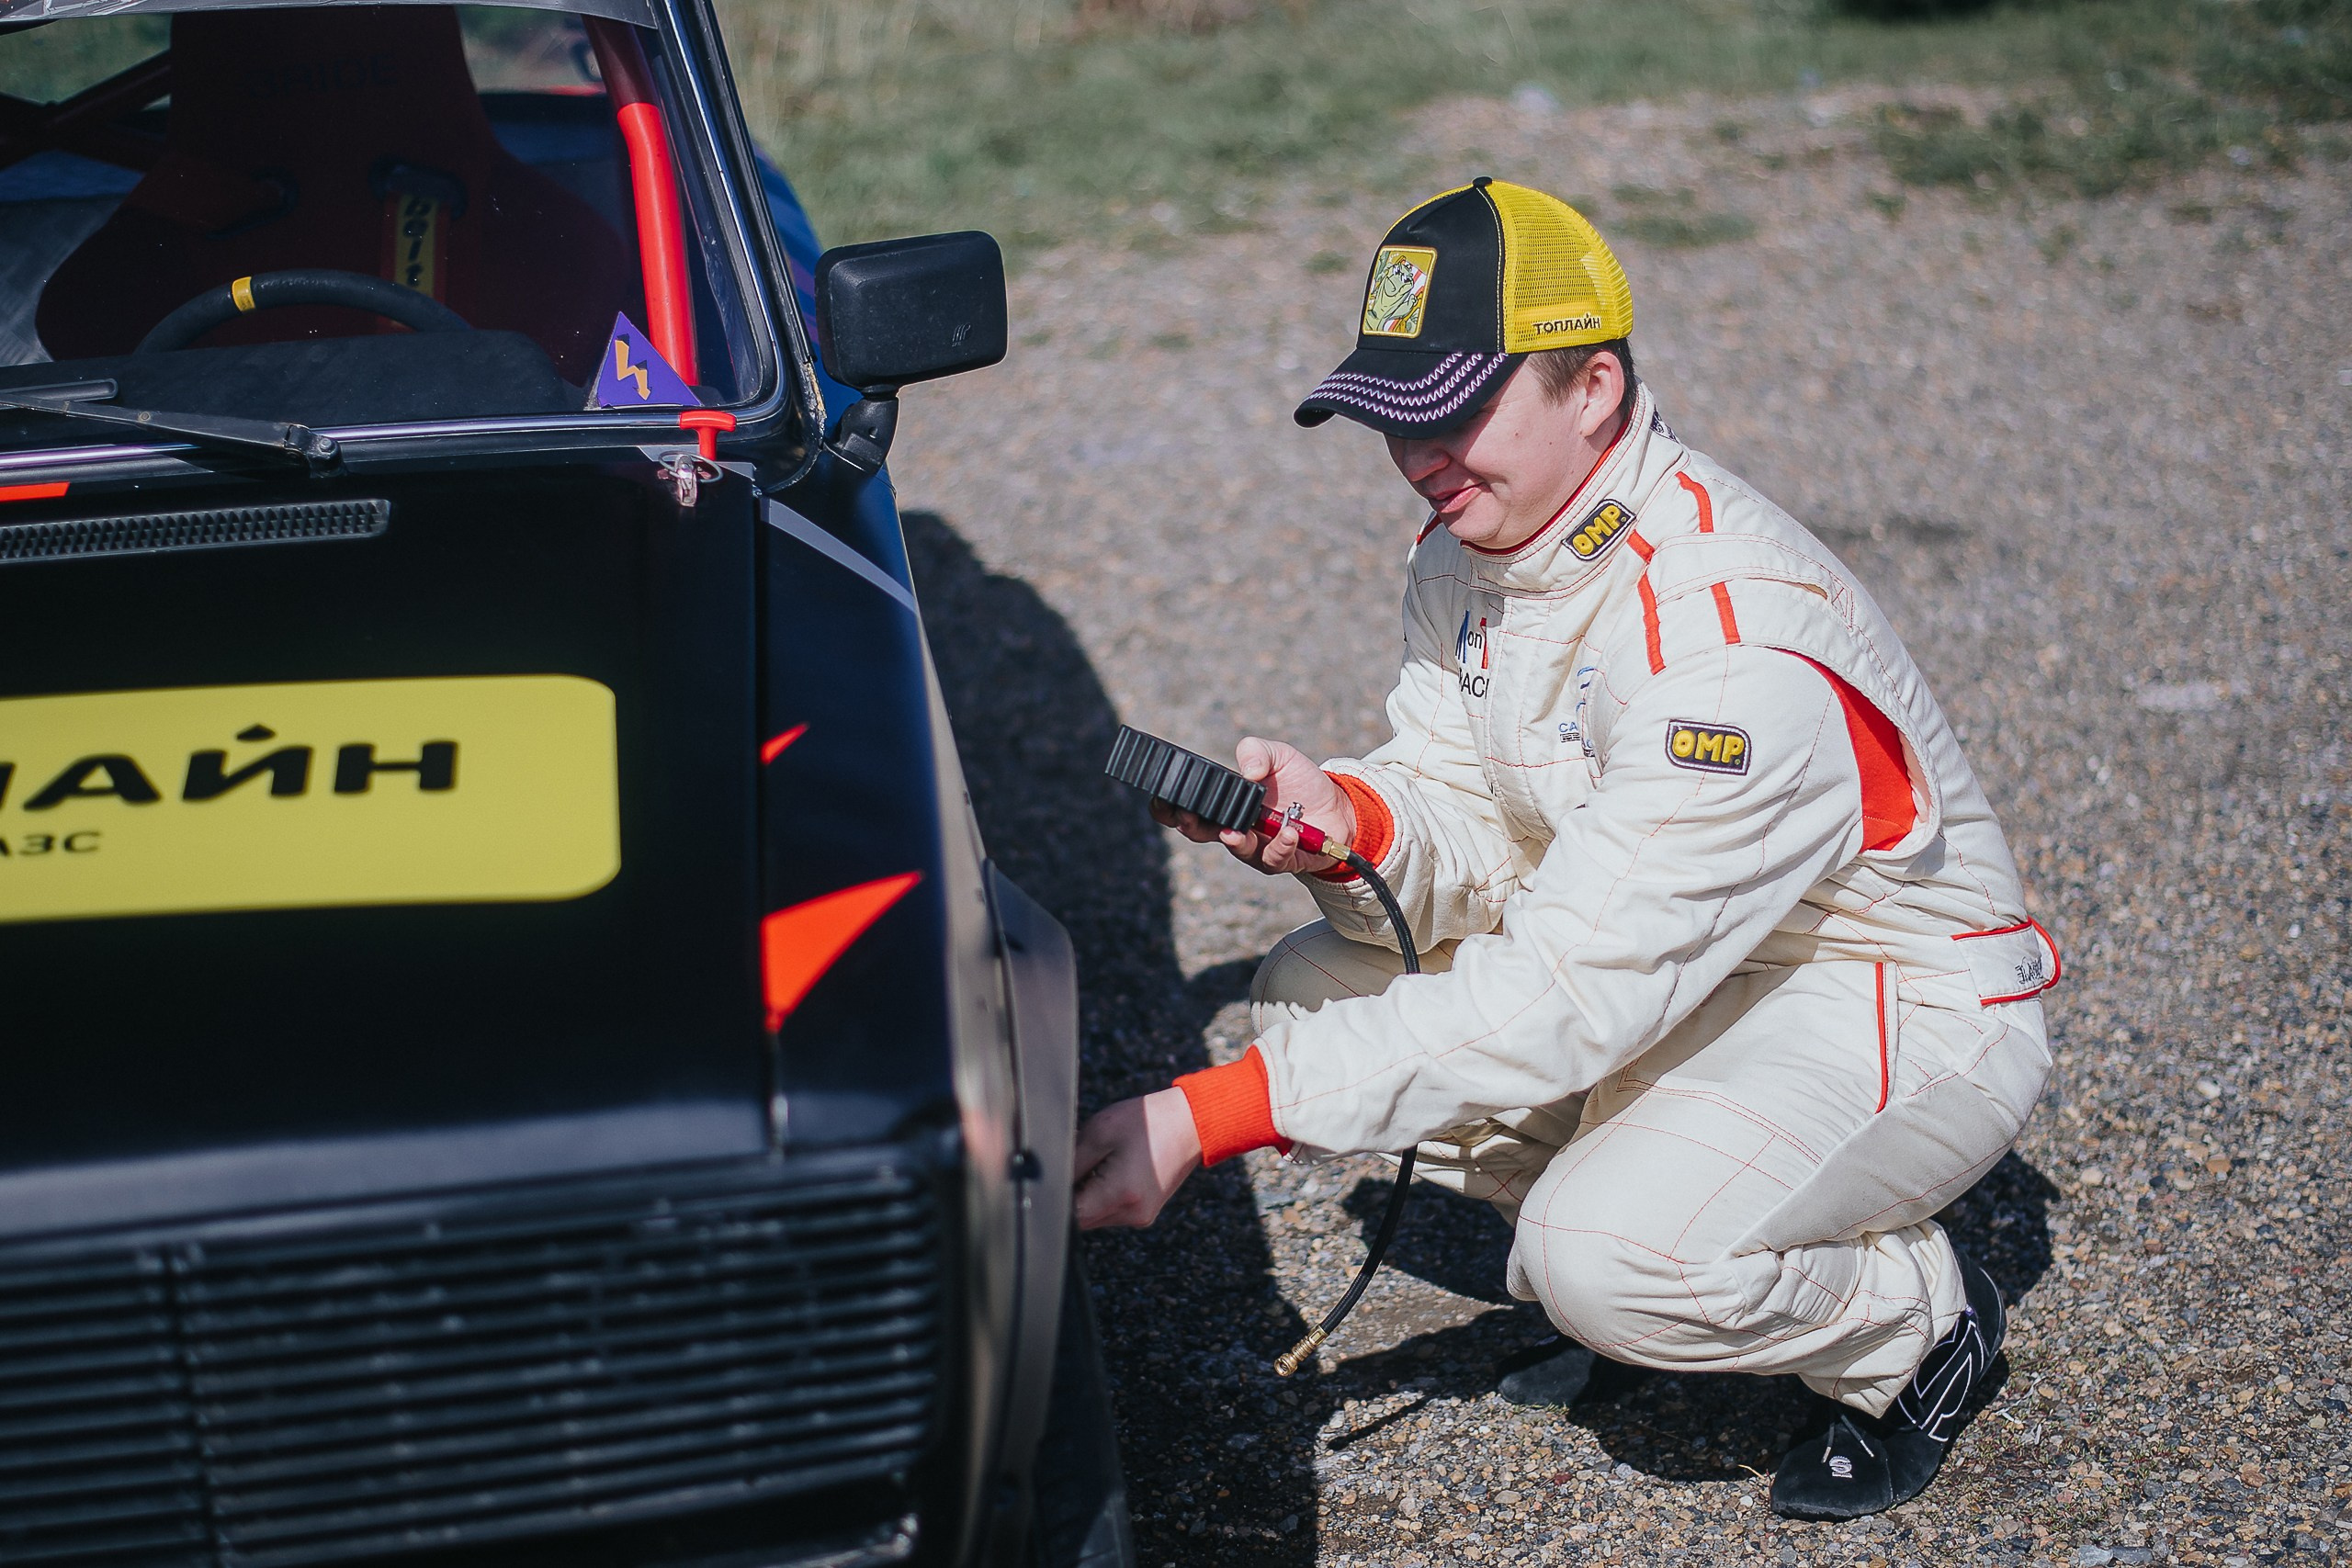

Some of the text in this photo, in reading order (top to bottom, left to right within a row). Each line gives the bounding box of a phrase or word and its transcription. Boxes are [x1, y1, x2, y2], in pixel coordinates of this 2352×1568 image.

[1532, 312, 1600, 335] ТОПЛАЙН
[1573, 505, 1622, 556] OMP
[1672, 730, 1745, 763] OMP
